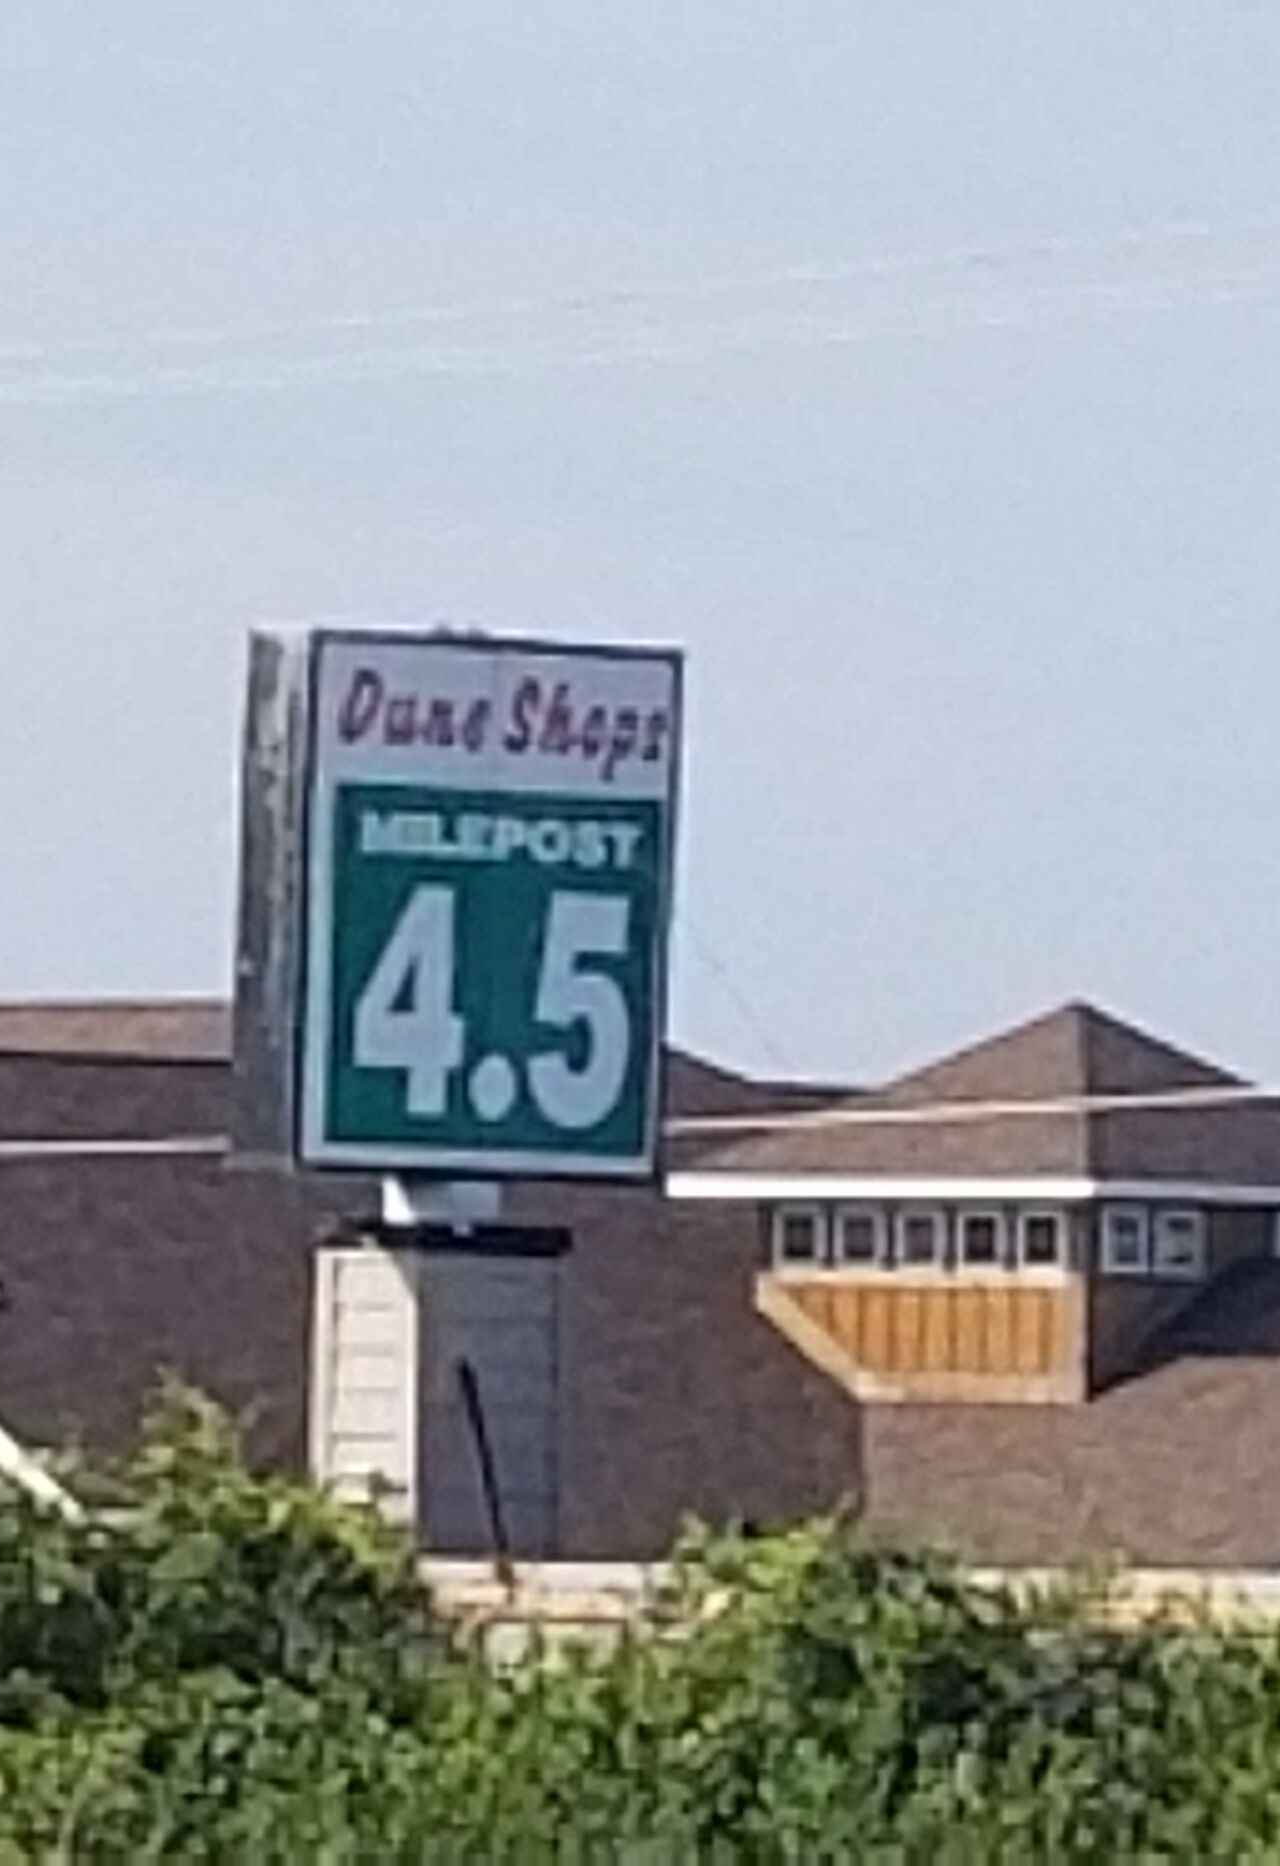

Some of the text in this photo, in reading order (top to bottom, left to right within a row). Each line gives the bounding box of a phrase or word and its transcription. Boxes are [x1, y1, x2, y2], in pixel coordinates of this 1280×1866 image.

[338, 667, 669, 783] Dune Shops
[360, 810, 645, 869] MILEPOST
[353, 881, 632, 1129] 4.5
